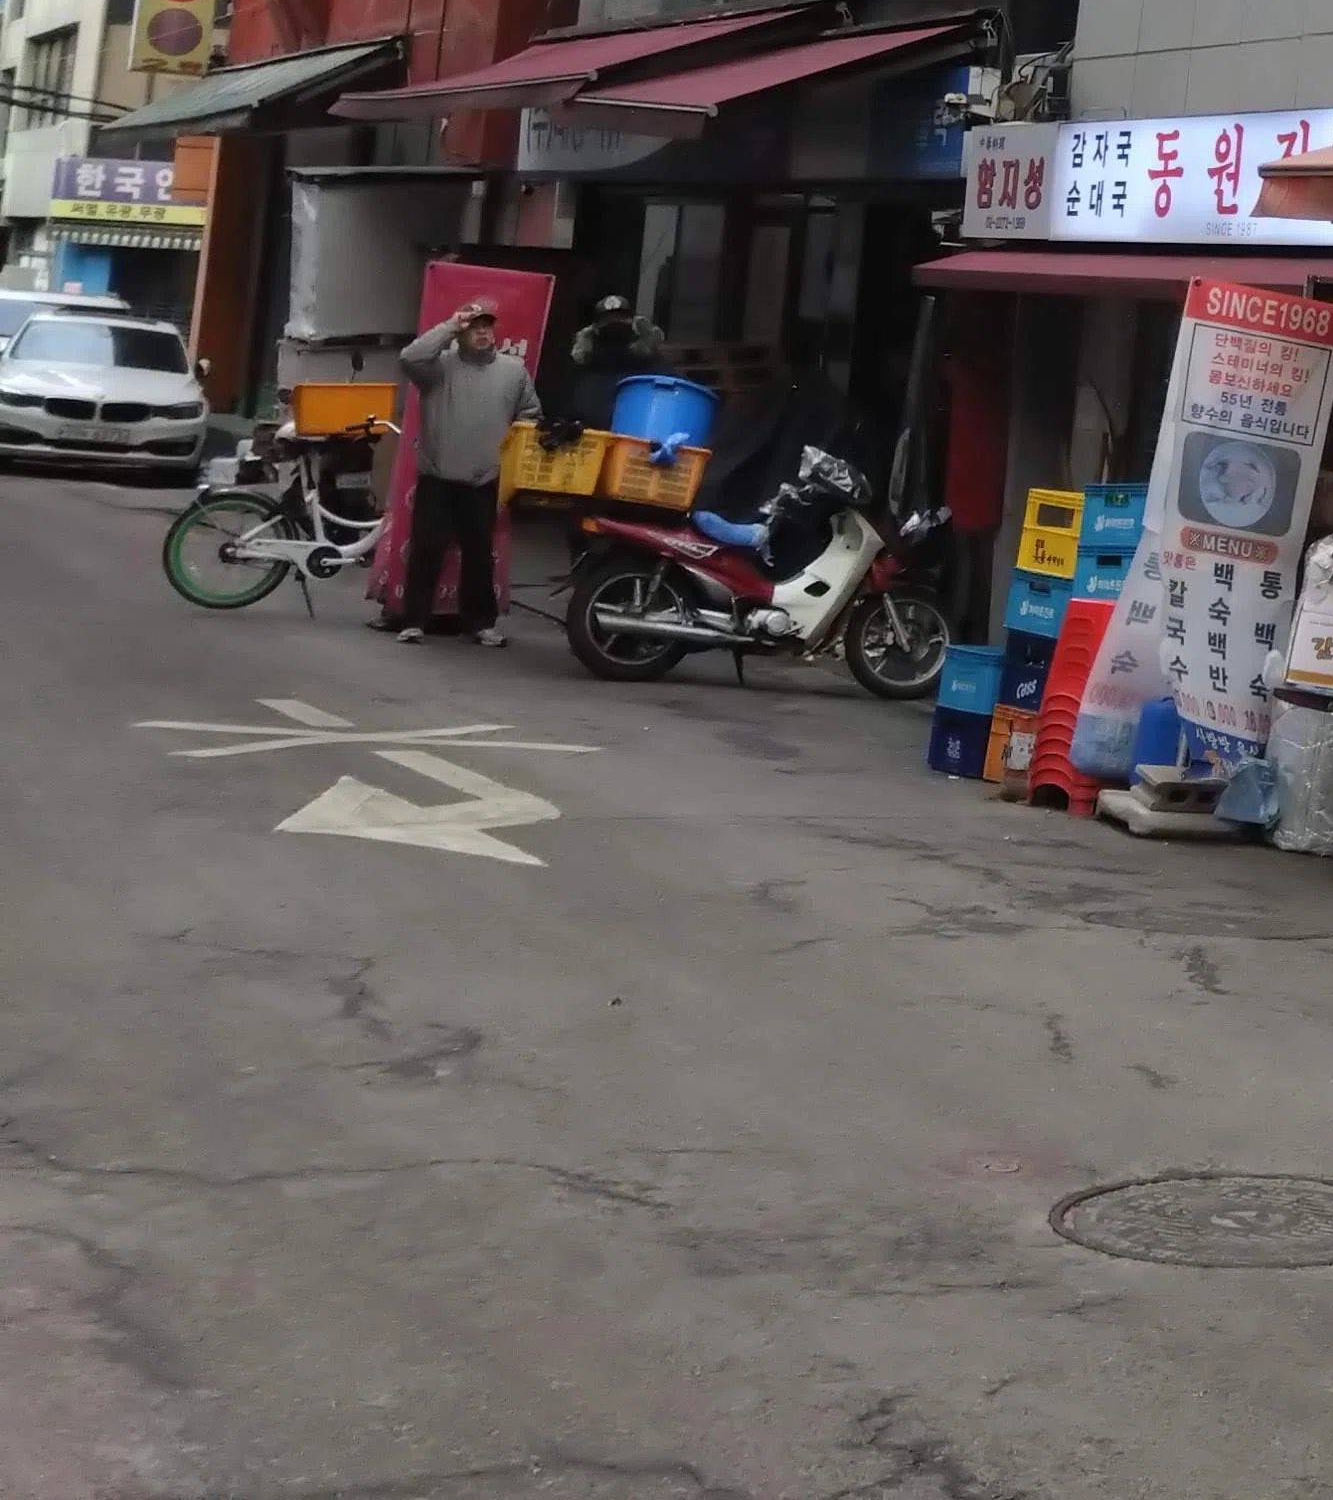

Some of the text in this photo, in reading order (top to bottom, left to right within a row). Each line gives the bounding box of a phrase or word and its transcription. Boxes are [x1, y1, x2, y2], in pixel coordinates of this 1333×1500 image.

[1071, 130, 1132, 169] 감자국
[1066, 180, 1127, 218] 순대국
[1165, 578, 1190, 682] 칼국수
[1208, 562, 1235, 694] 백숙백반
